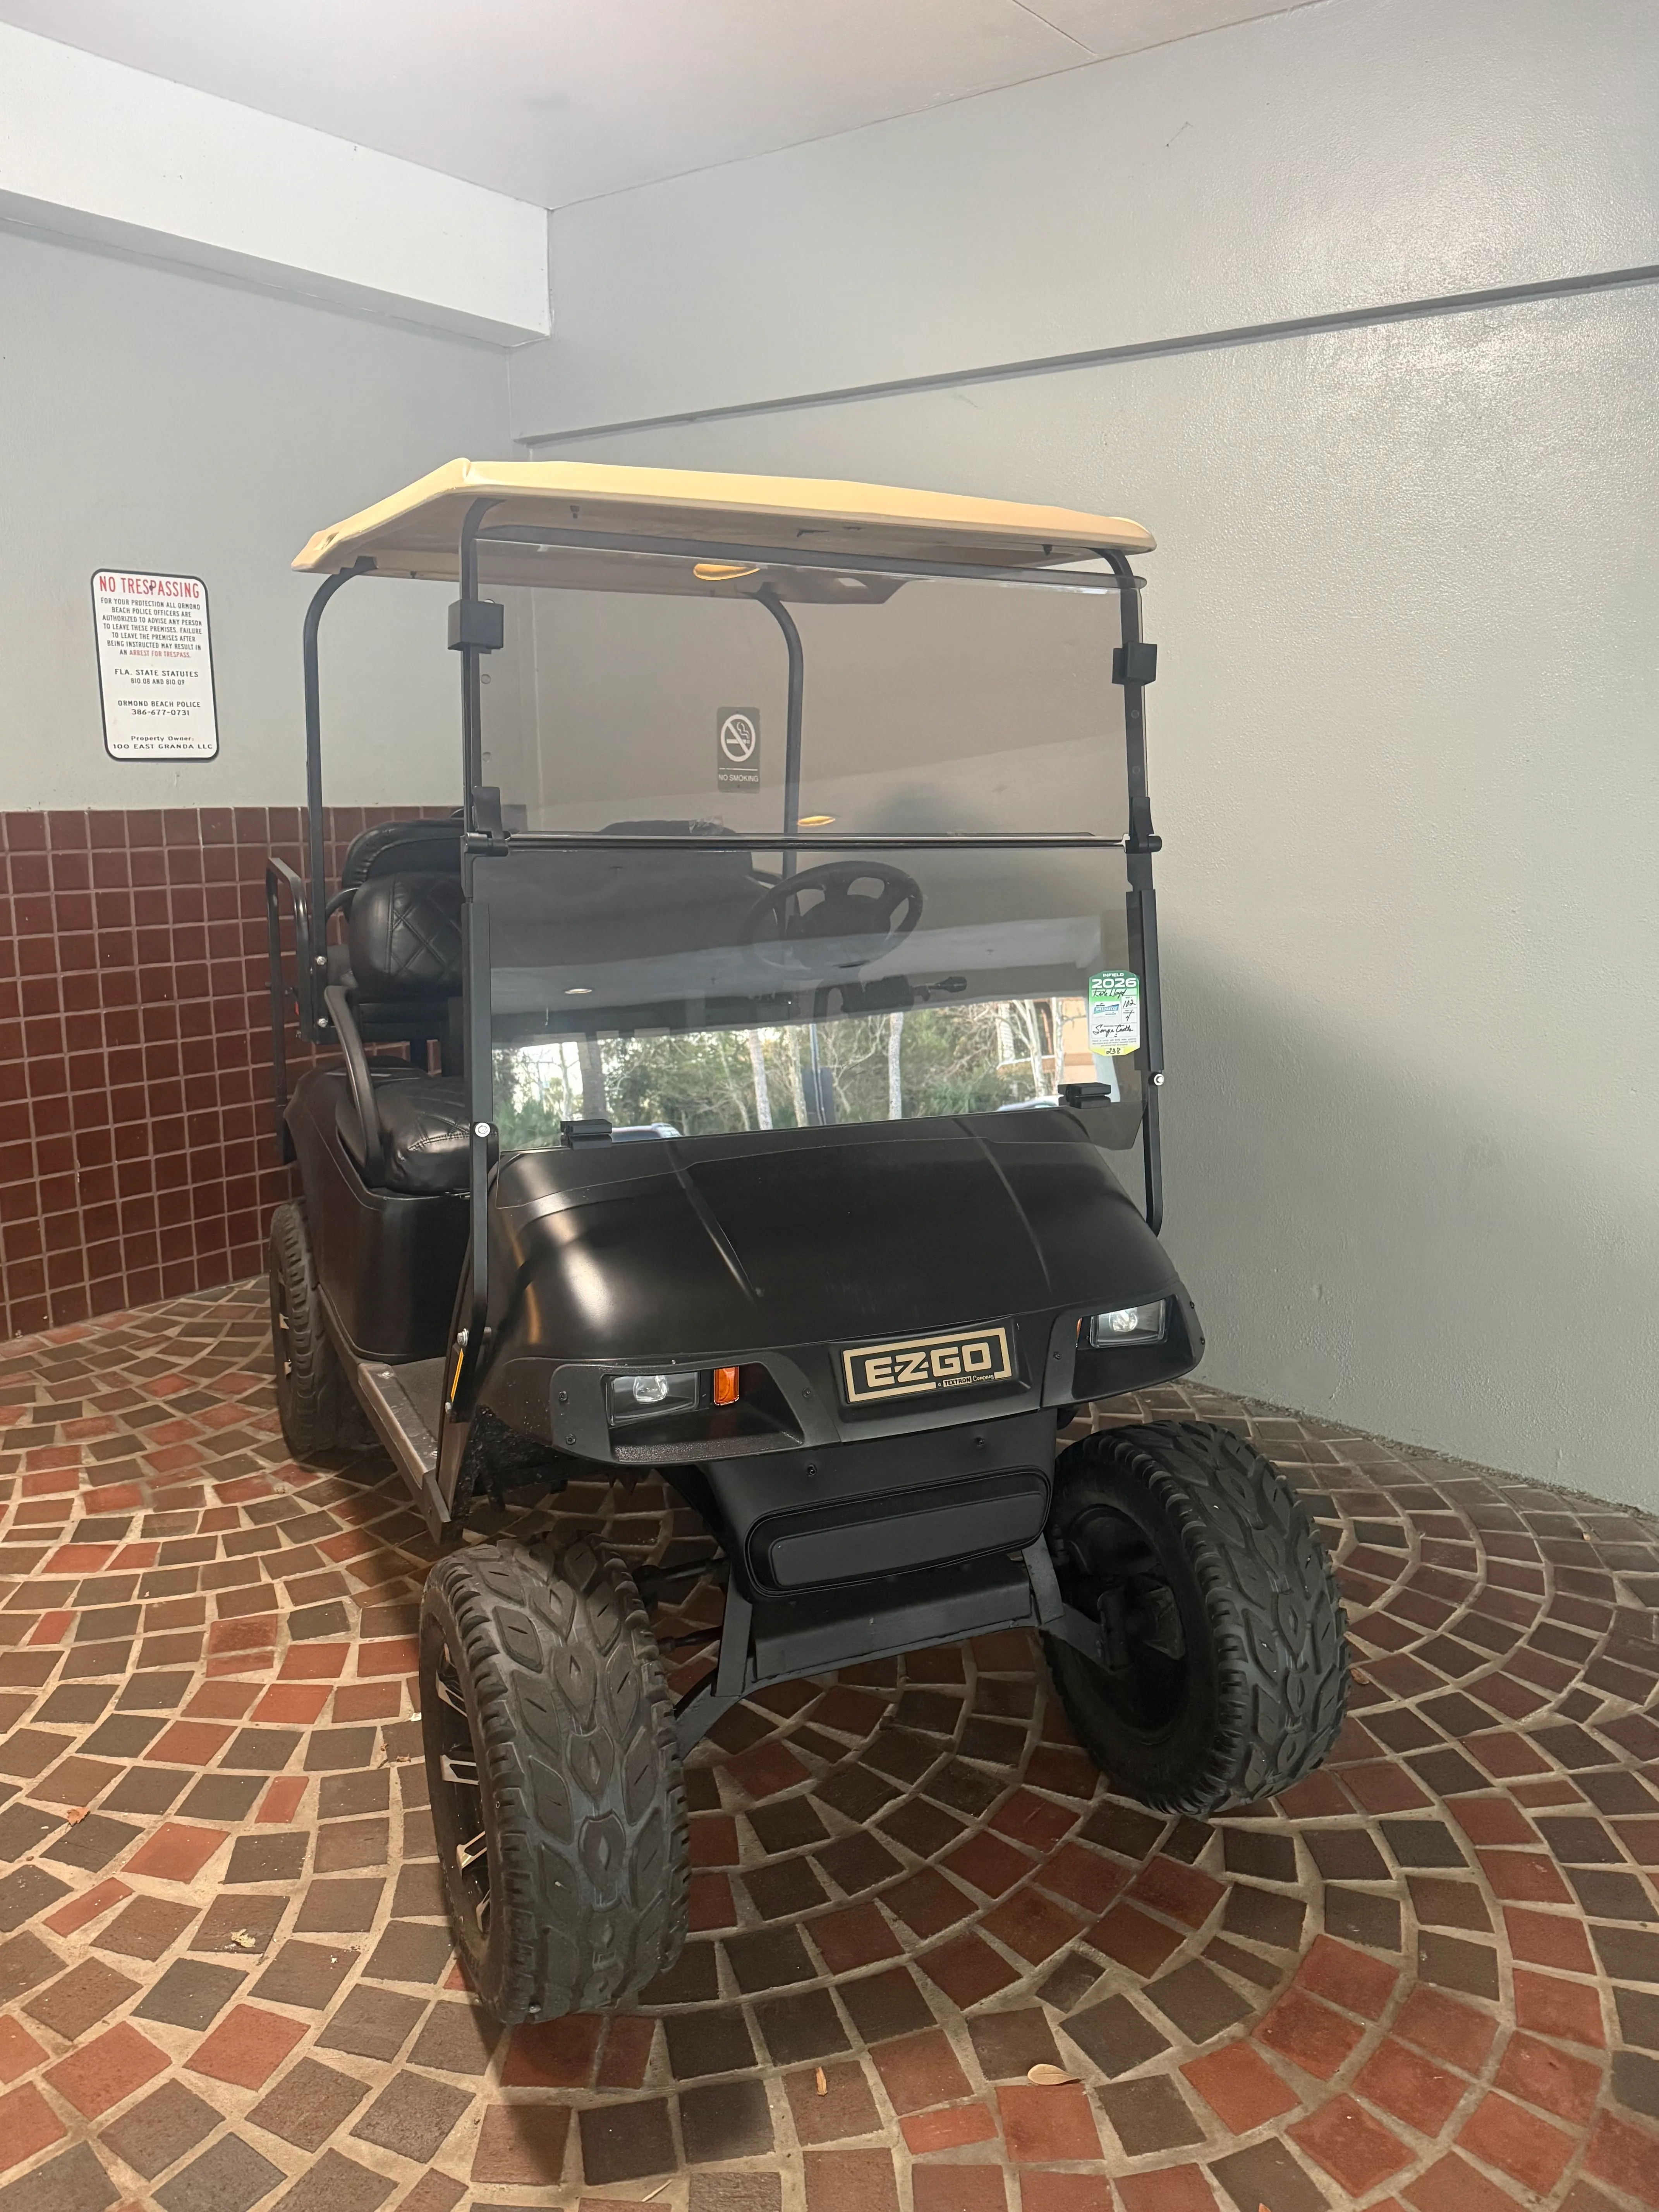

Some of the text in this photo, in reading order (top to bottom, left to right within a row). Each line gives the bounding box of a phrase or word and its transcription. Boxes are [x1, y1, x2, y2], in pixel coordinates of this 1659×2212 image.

[100, 576, 199, 598] NO TRESPASSING
[1092, 977, 1137, 989] 2026
[1123, 999, 1136, 1008] 102
[944, 1376, 971, 1386] TEXTRON
